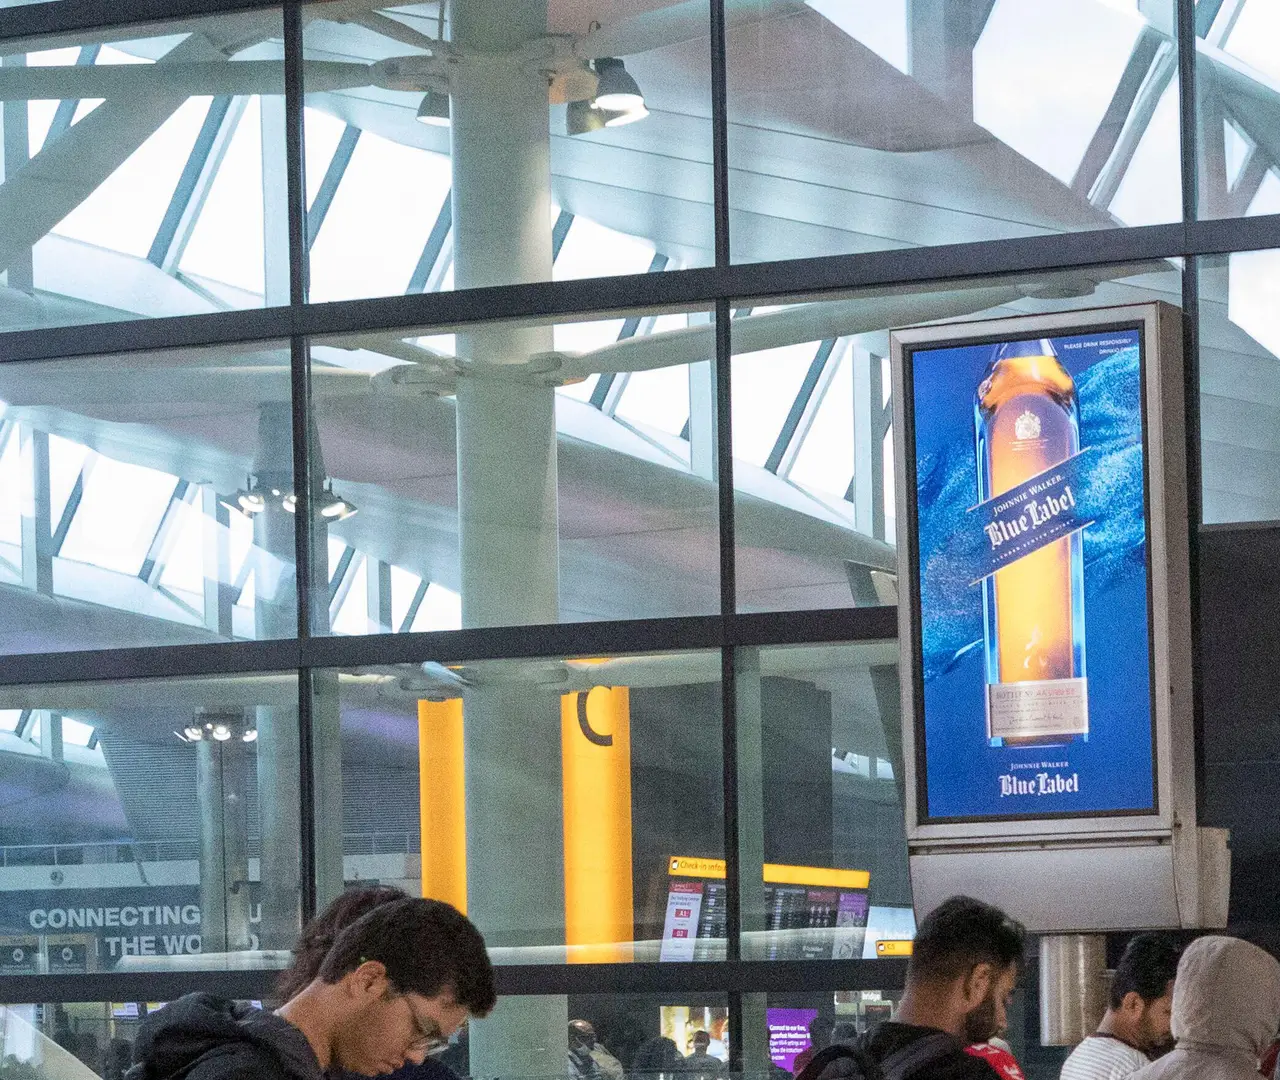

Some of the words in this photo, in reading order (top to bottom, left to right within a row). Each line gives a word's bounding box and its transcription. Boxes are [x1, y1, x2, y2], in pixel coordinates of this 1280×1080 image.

[993, 493, 1028, 517] JOHNNIE
[1029, 474, 1062, 496] WALKER
[984, 515, 1029, 550] Blue
[1024, 486, 1075, 530] Label
[1011, 762, 1039, 771] JOHNNIE
[998, 774, 1035, 797] Blue
[1036, 772, 1078, 796] Label
[29, 904, 200, 930] CONNECTING
[104, 936, 155, 956] THE
